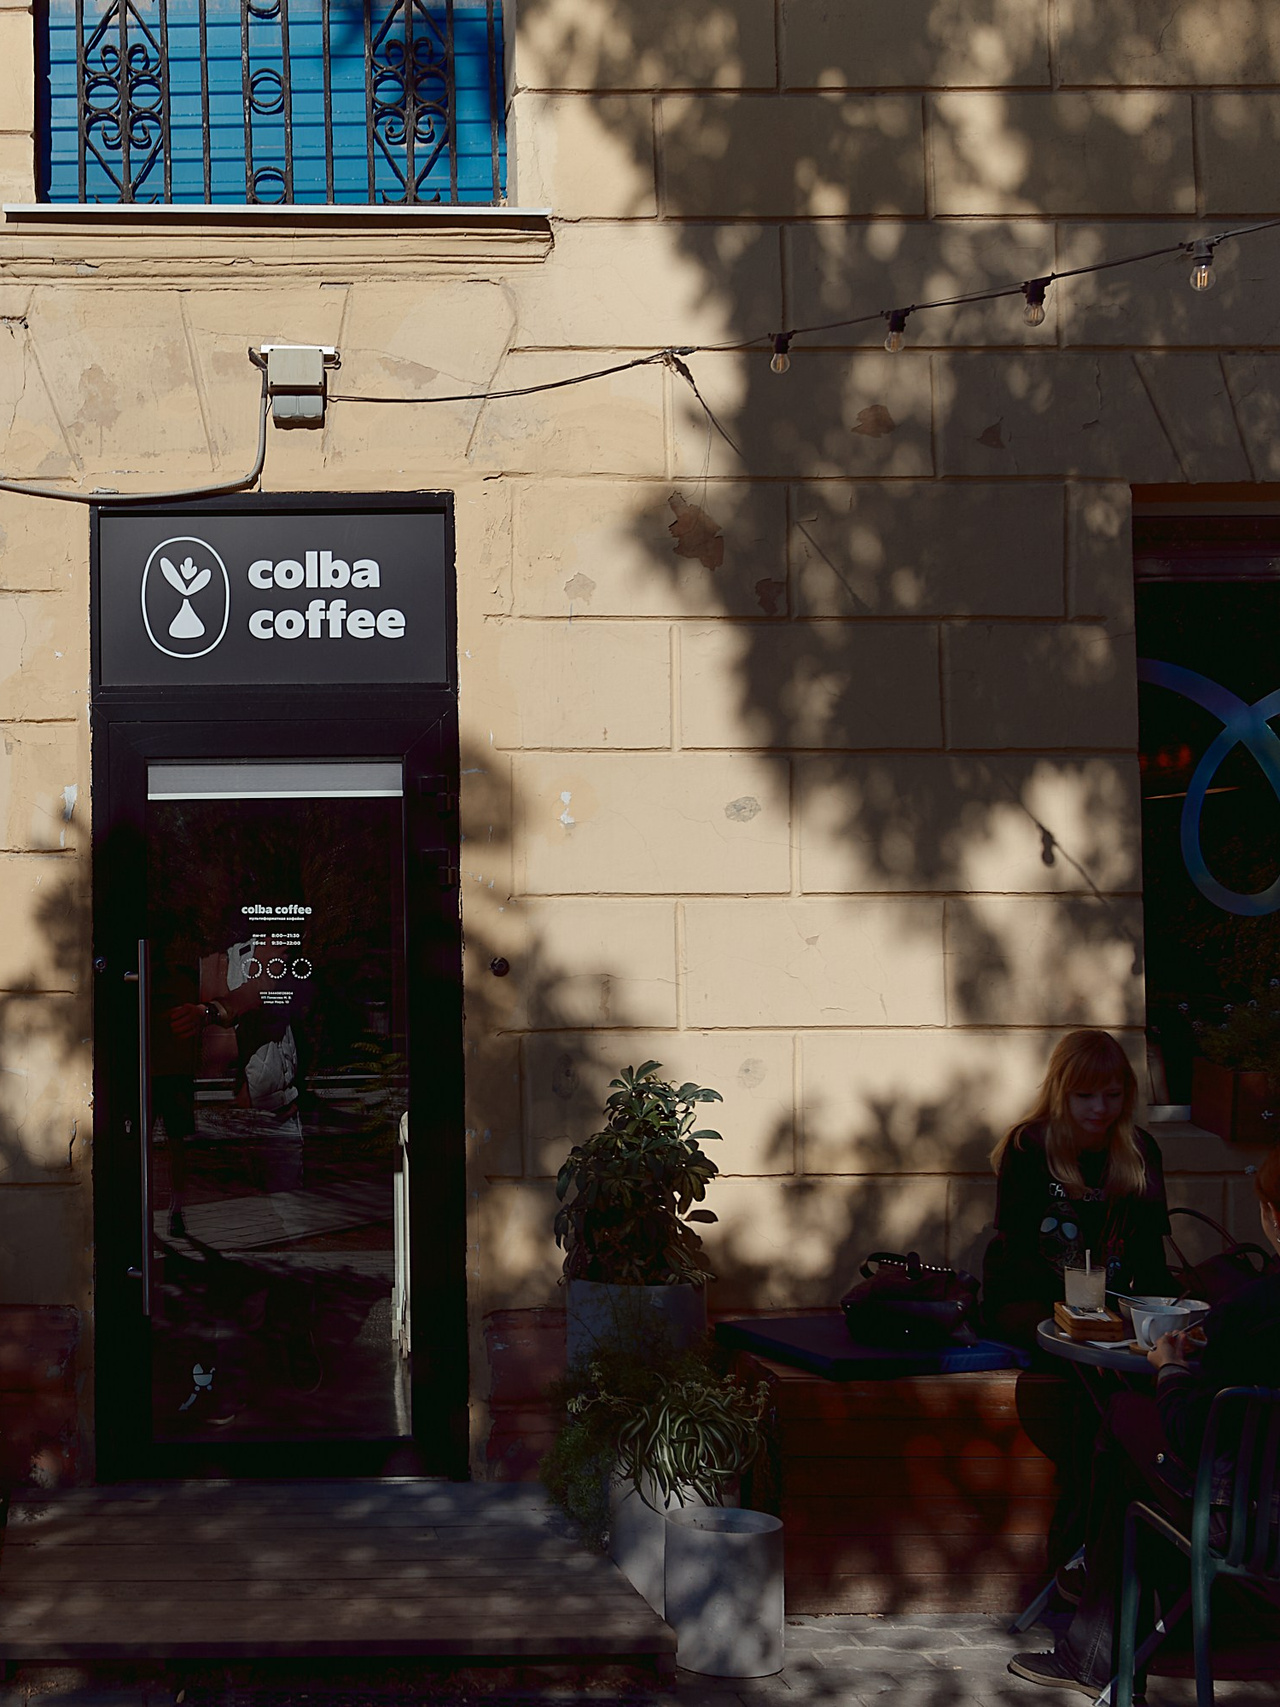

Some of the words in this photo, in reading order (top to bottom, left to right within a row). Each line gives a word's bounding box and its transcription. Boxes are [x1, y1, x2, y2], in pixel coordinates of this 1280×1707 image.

[248, 551, 380, 589] colba
[248, 599, 406, 639] coffee
[241, 904, 273, 914] colba
[275, 904, 312, 914] coffee
